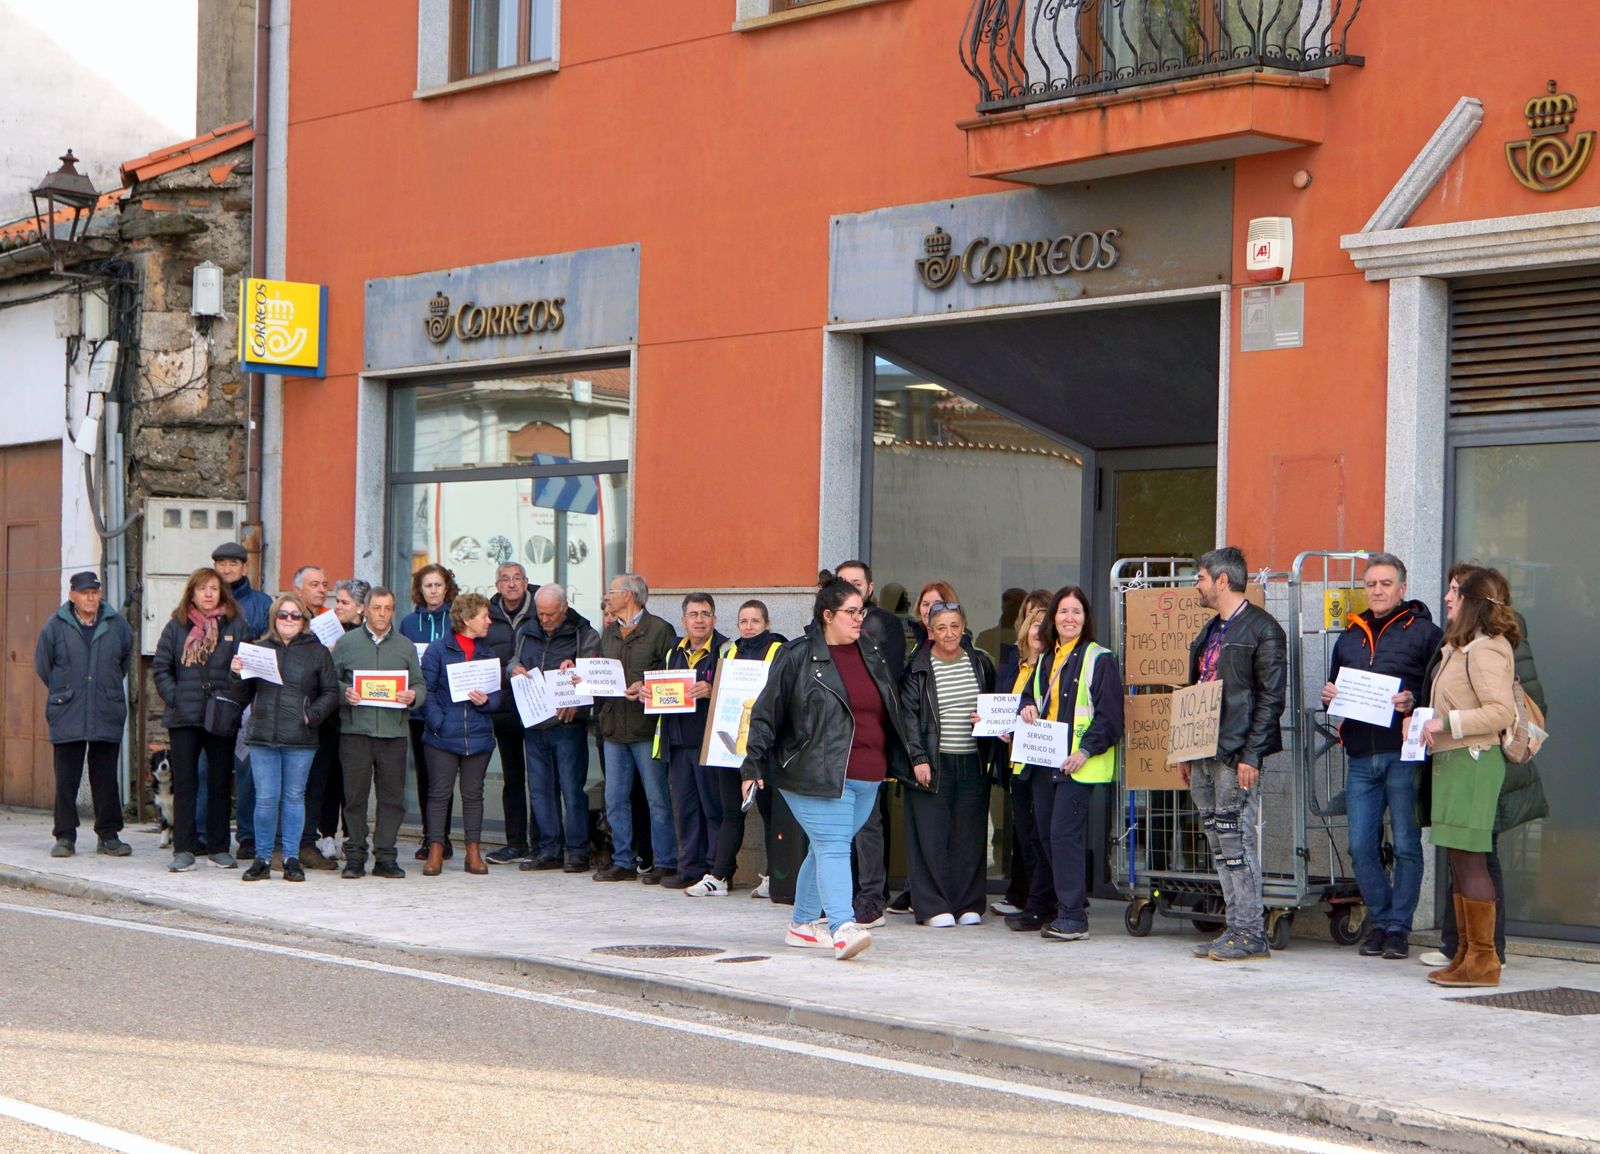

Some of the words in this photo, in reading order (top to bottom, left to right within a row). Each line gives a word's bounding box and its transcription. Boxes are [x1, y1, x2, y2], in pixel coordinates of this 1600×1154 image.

[961, 229, 1122, 284] CORREOS
[251, 283, 267, 358] CORREOS
[454, 297, 565, 340] CORREOS
[1163, 598, 1173, 610] 5
[1150, 613, 1170, 630] 79
[1139, 657, 1184, 677] CALIDAD
[660, 696, 679, 704] POSTAL
[1151, 697, 1171, 715] POR
[1180, 693, 1196, 718] NO
[1197, 690, 1207, 714] A
[1134, 719, 1169, 733] DIGNO
[1027, 732, 1053, 741] SERVICIO
[1023, 743, 1047, 752] PUBLICO
[1027, 756, 1051, 765] CALIDAD
[1140, 758, 1152, 772] DE
